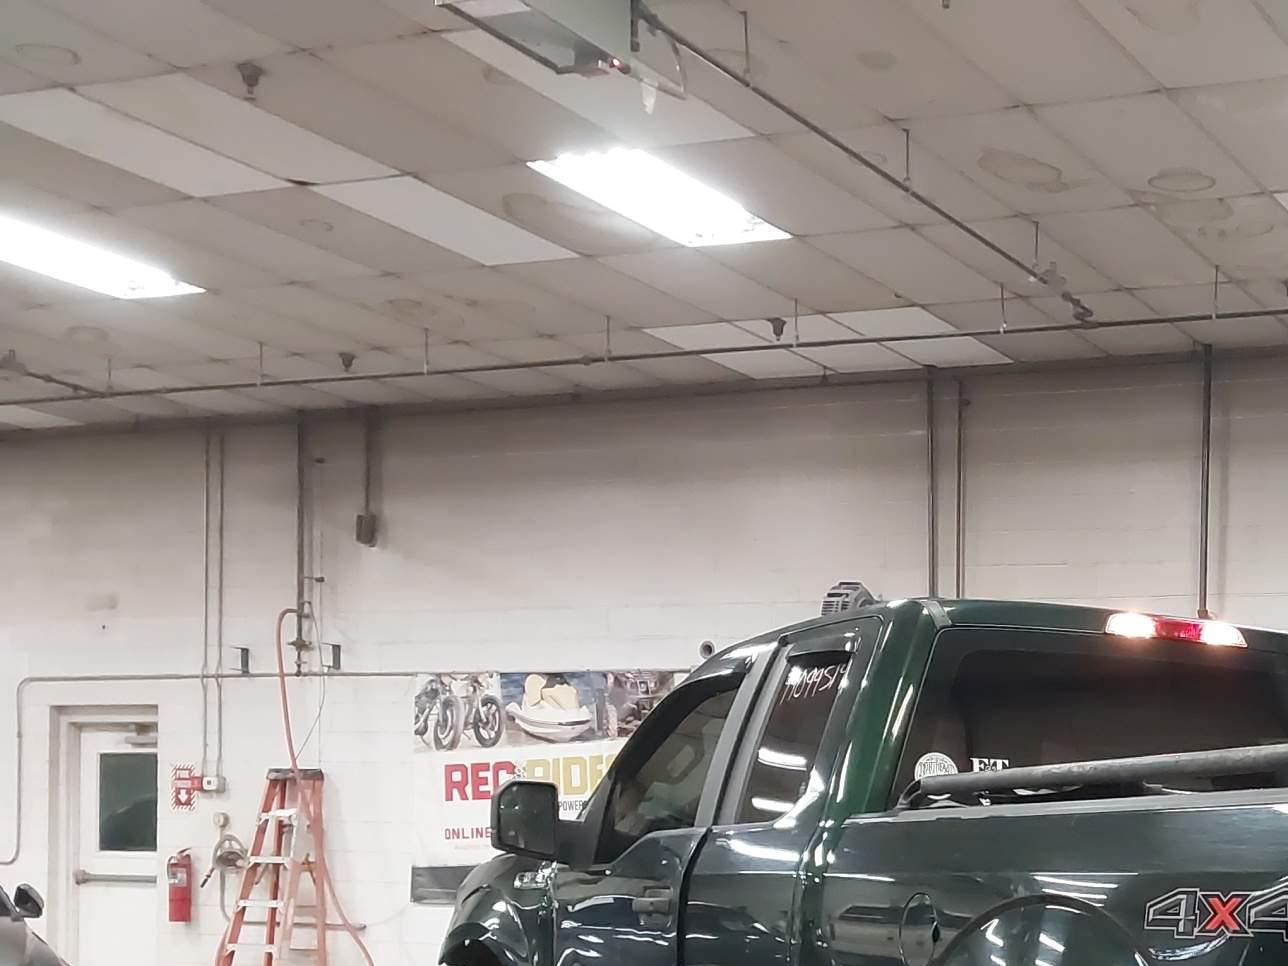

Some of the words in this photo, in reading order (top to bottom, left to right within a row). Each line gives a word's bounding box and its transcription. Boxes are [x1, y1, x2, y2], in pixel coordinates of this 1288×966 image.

[444, 761, 516, 802] REC
[526, 753, 617, 796] RIDE
[558, 800, 588, 811] POWER
[444, 827, 492, 840] ONLINE
